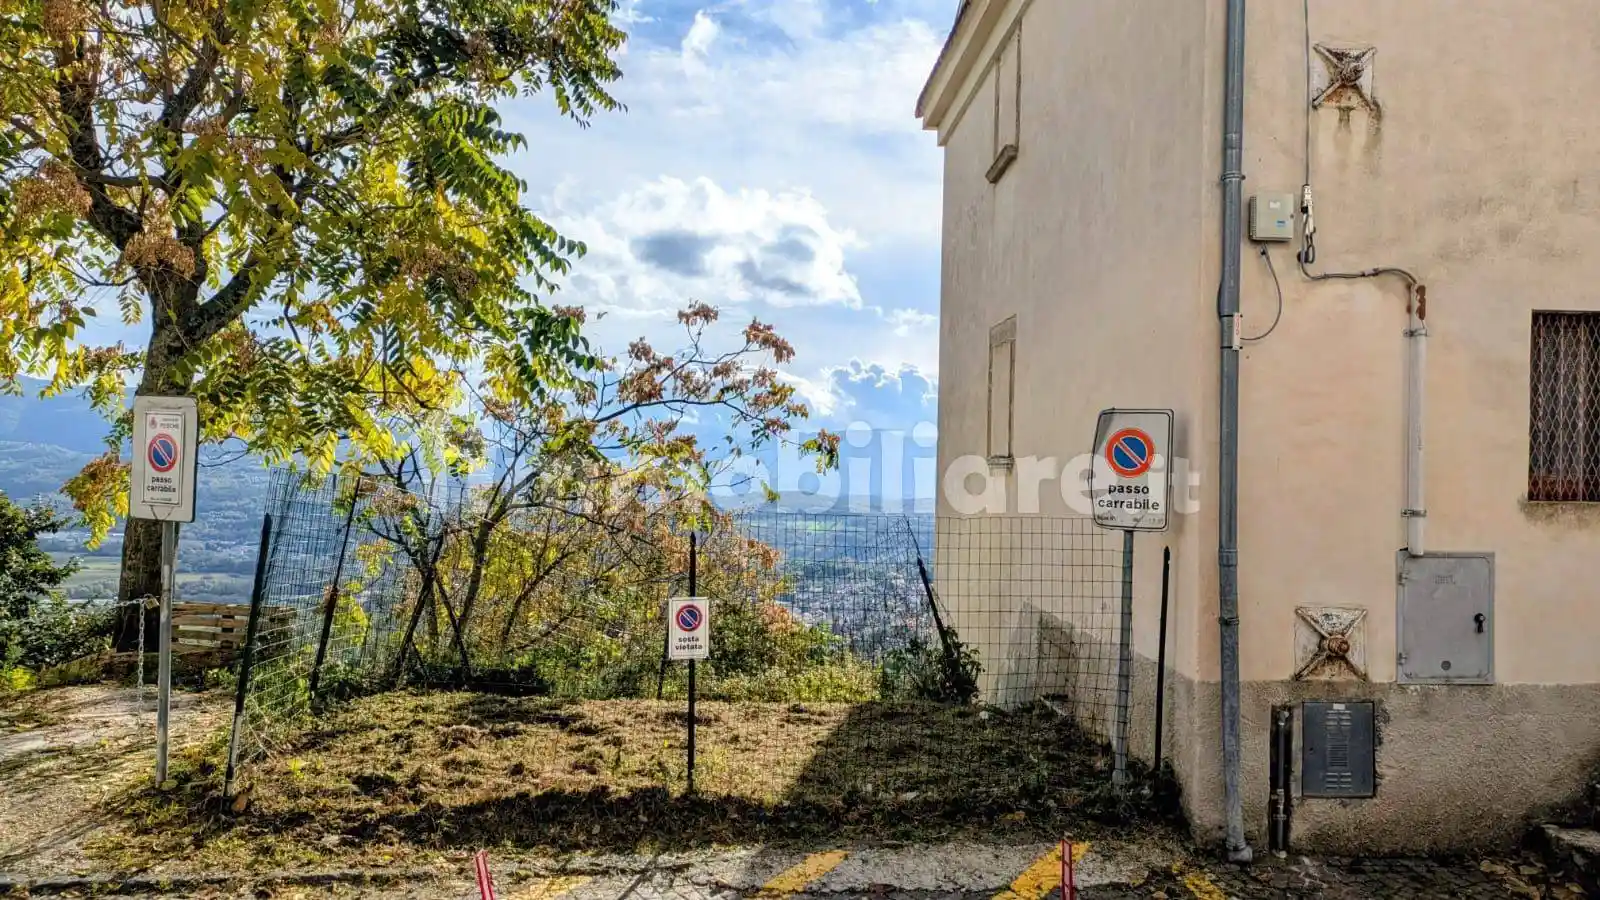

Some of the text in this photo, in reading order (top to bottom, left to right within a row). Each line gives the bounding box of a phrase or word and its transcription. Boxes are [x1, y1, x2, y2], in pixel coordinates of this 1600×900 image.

[151, 476, 172, 484] passo
[147, 484, 176, 493] carrabile
[1108, 485, 1149, 495] passo
[1098, 499, 1160, 510] carrabile
